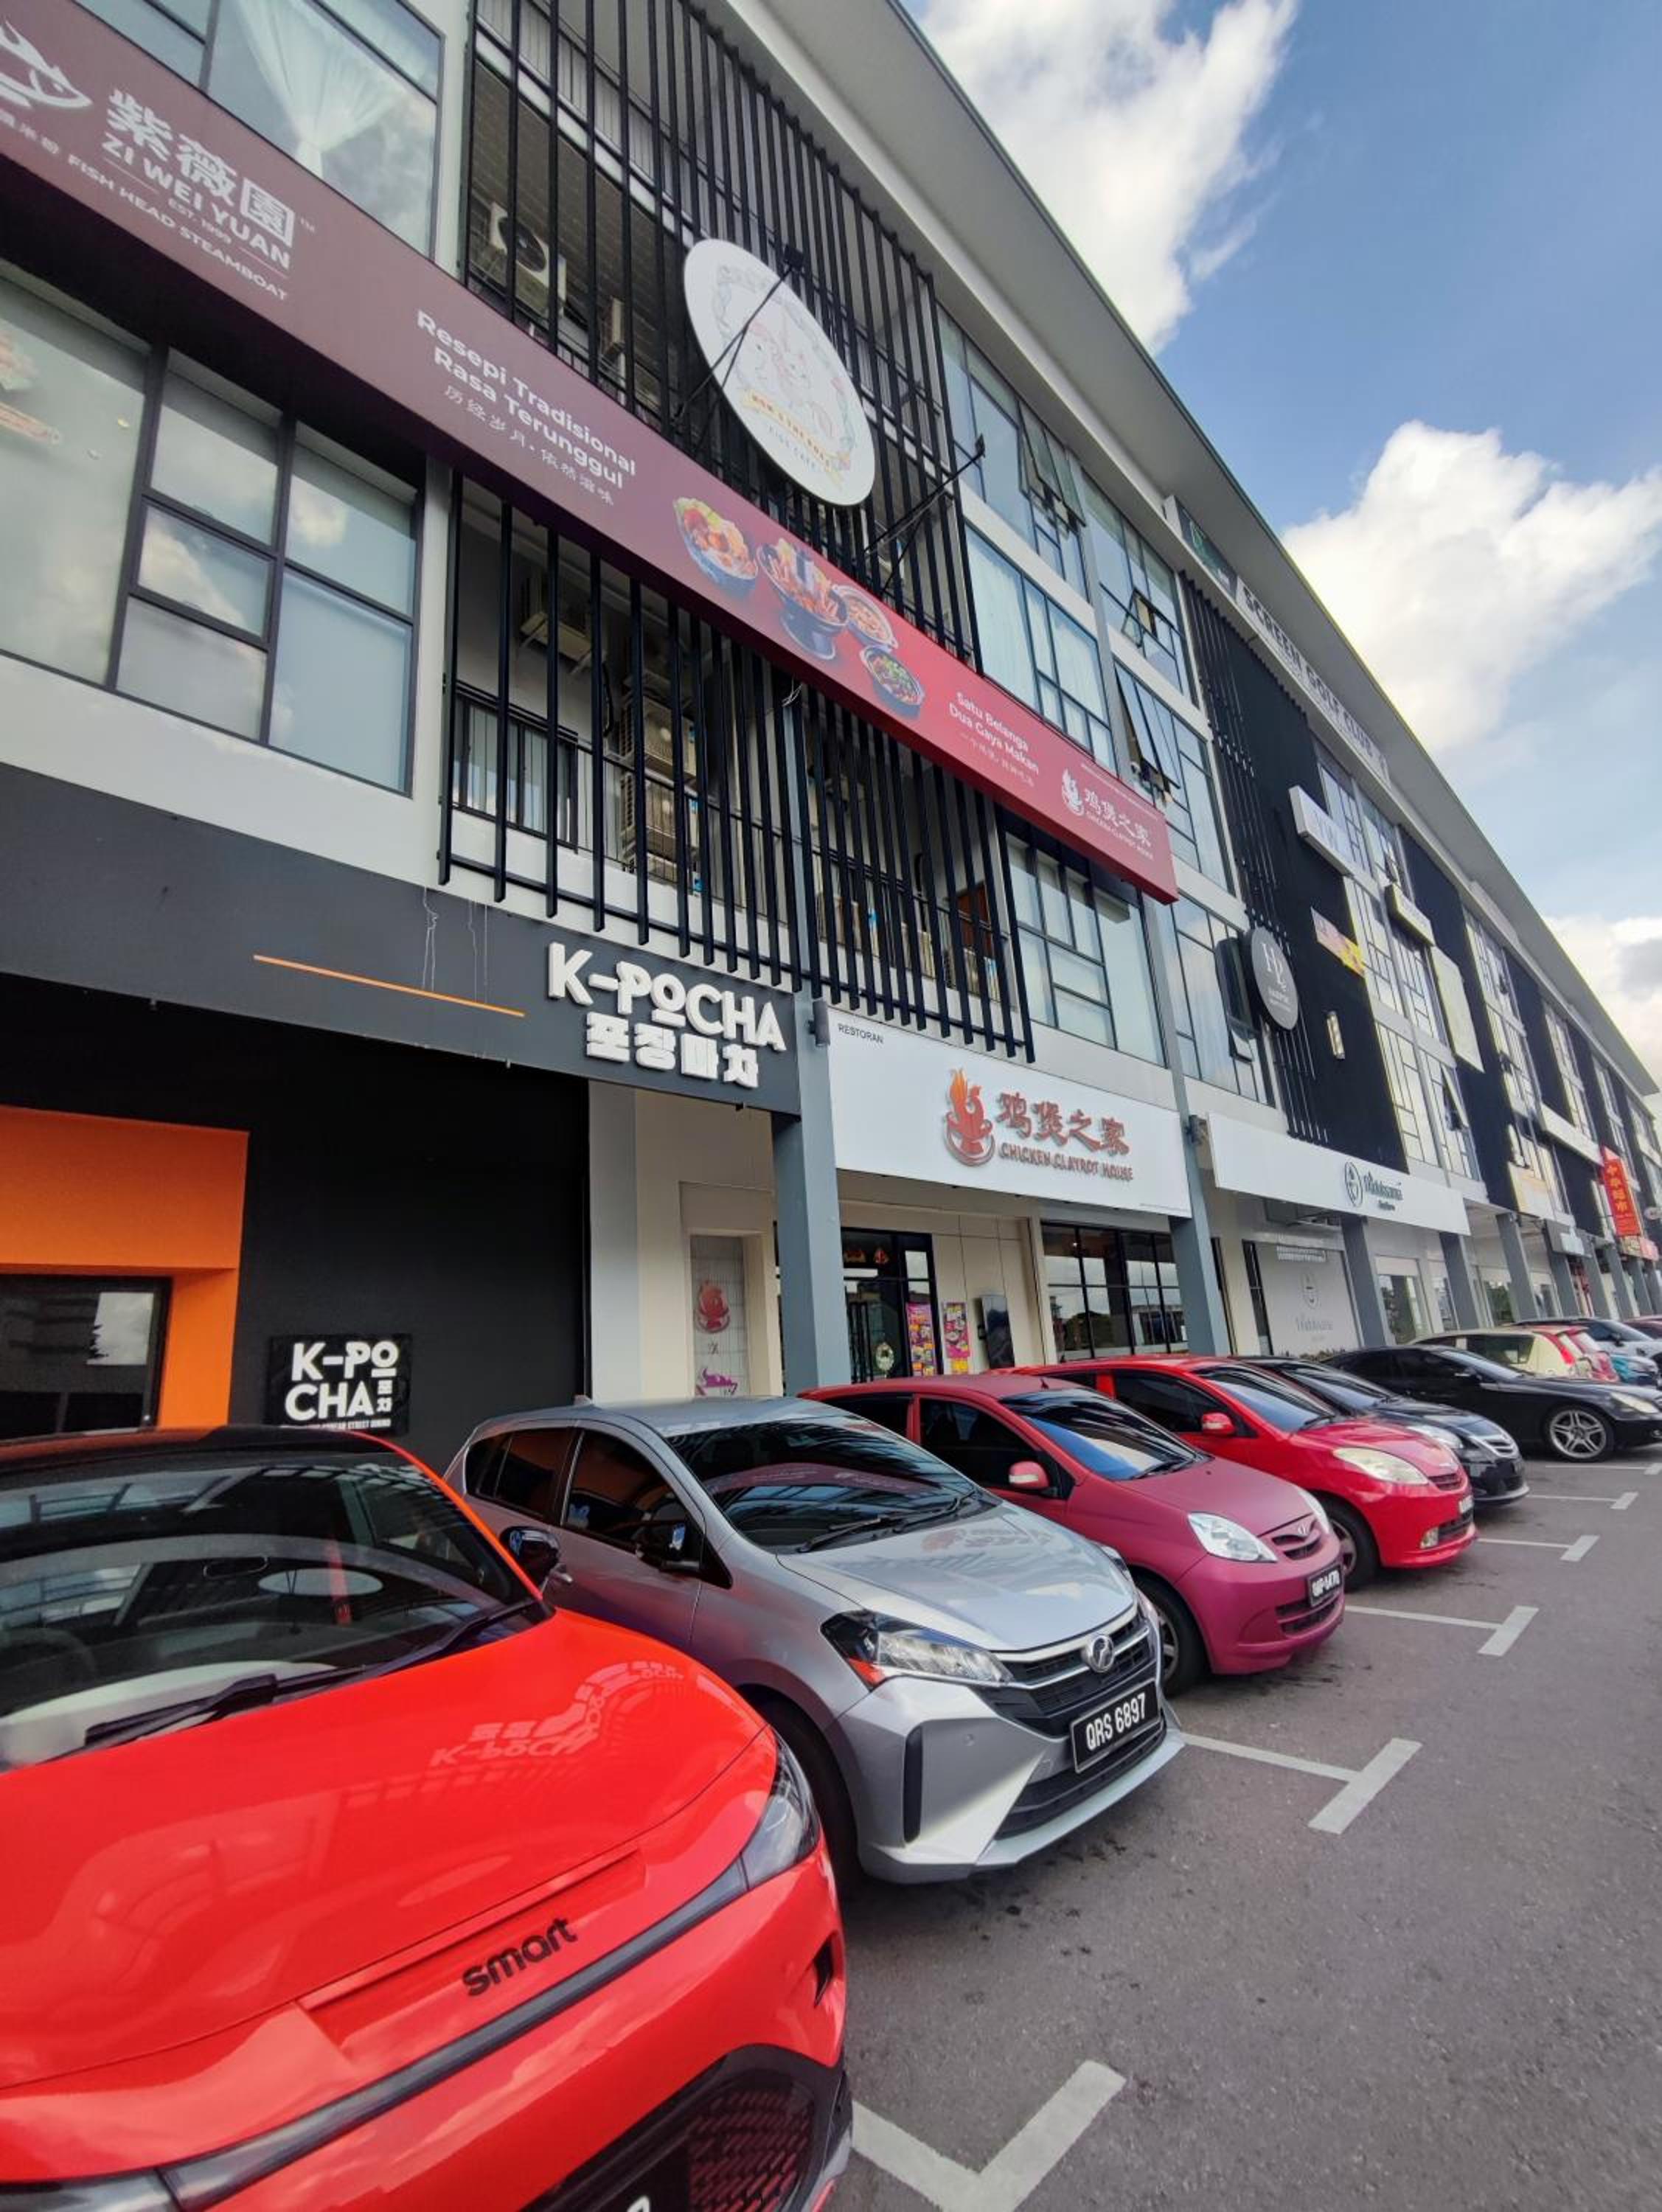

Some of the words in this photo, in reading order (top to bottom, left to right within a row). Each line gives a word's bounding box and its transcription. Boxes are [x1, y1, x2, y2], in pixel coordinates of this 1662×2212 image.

[68, 153, 114, 191] FISH
[119, 187, 176, 228] HEAD
[179, 225, 288, 301] STEAMBOAT
[102, 131, 135, 166] ZI
[143, 156, 203, 212] WEI
[211, 201, 291, 271] YUAN
[417, 308, 507, 386] Resepi
[513, 375, 636, 477] Tradisional
[434, 345, 497, 403] Rasa
[504, 392, 624, 490] Terunggul
[547, 941, 787, 1052] K-POCHA
[837, 1022, 884, 1044] RESTORAN
[995, 1091, 1131, 1158] 鸡煲之家
[998, 1141, 1051, 1168] CHICKEN
[1101, 1161, 1134, 1181] HOUSE
[285, 1380, 375, 1422] CHA
[1085, 1713, 1113, 1752] QRS
[1114, 1691, 1147, 1733] 6897
[462, 1918, 579, 1997] smart
